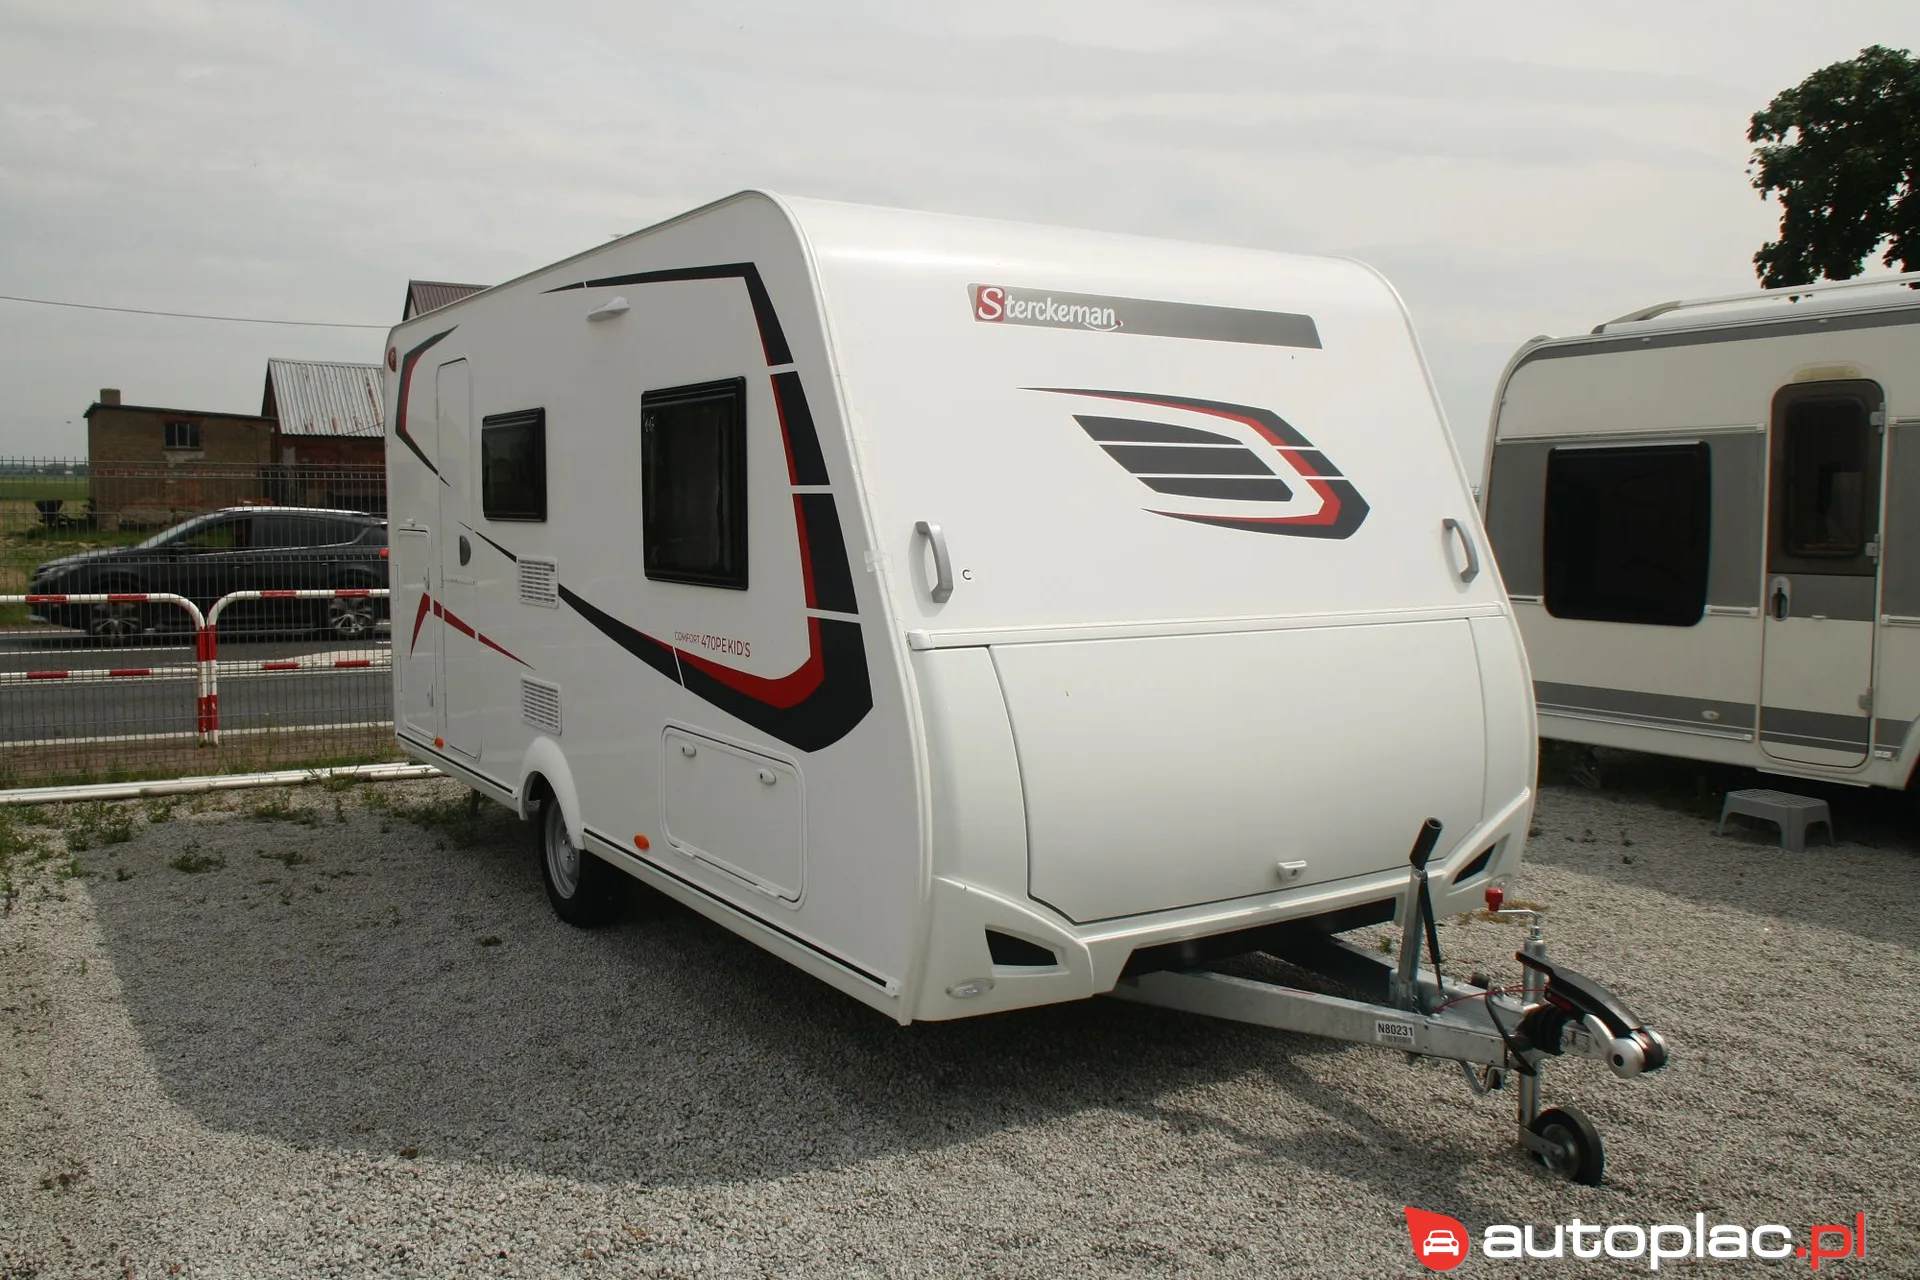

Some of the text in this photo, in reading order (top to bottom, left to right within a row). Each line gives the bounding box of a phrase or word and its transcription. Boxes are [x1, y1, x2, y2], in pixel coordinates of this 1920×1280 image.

[978, 287, 1117, 327] Sterckeman
[674, 631, 700, 644] COMFORT
[1377, 1022, 1414, 1037] N80231
